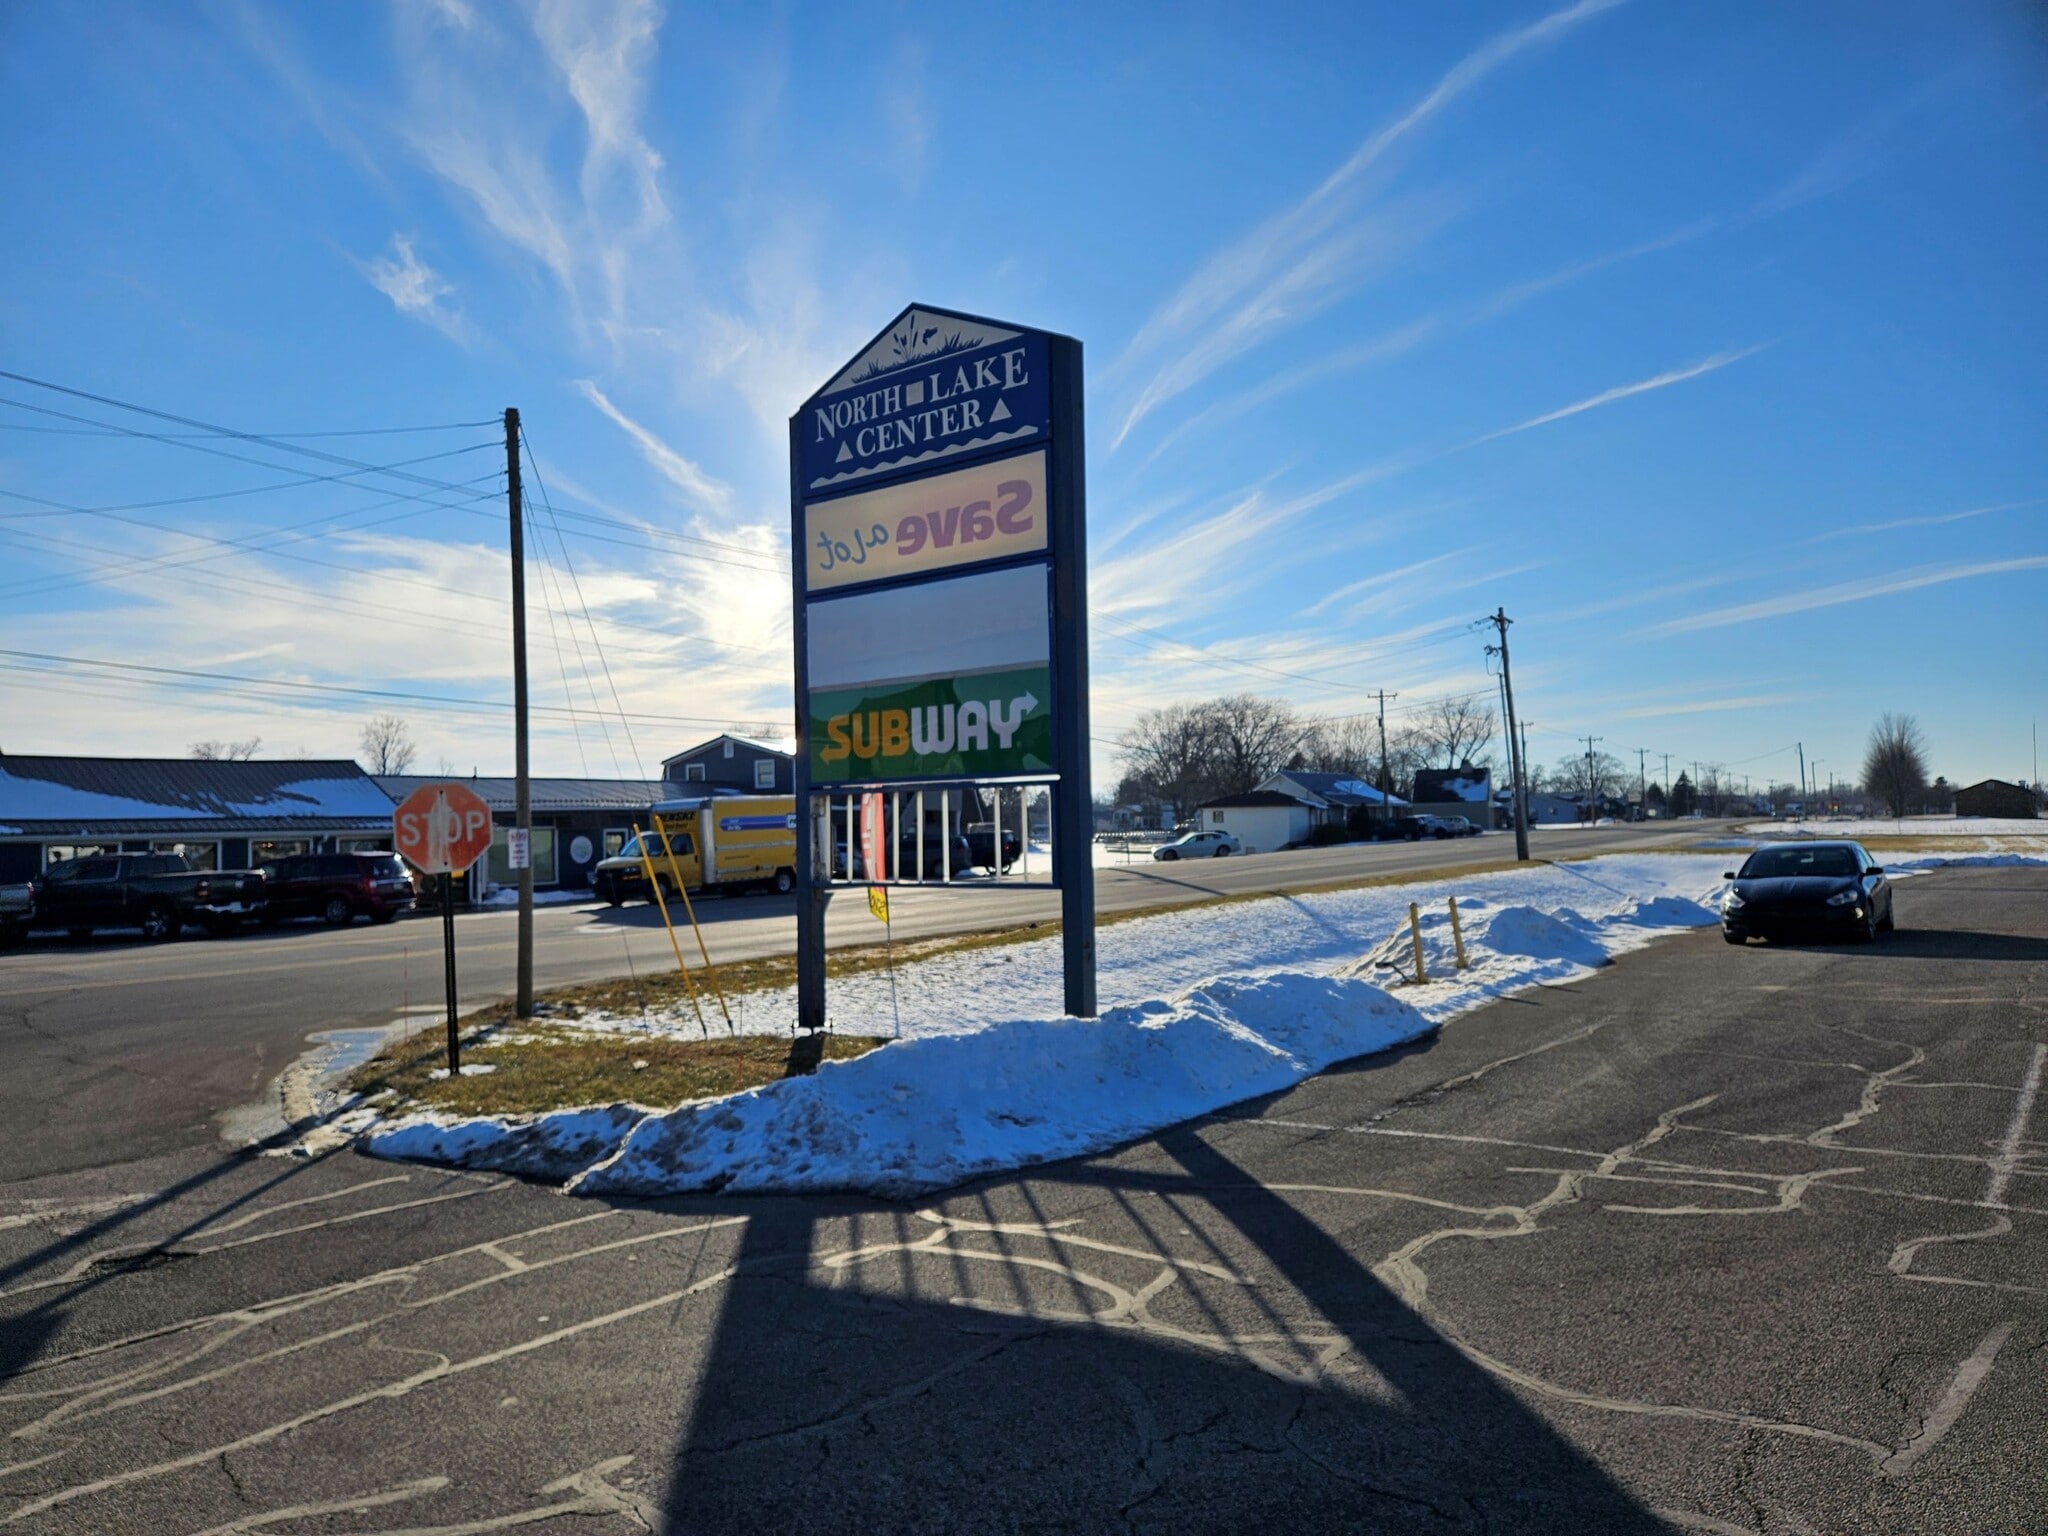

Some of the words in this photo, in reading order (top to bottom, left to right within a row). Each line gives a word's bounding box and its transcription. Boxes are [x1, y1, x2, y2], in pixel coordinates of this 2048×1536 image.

[815, 383, 902, 442] NORTH
[929, 348, 1029, 403] LAKE
[855, 399, 984, 457] CENTER
[819, 690, 1039, 766] SUBWAY
[401, 811, 485, 847] STOP
